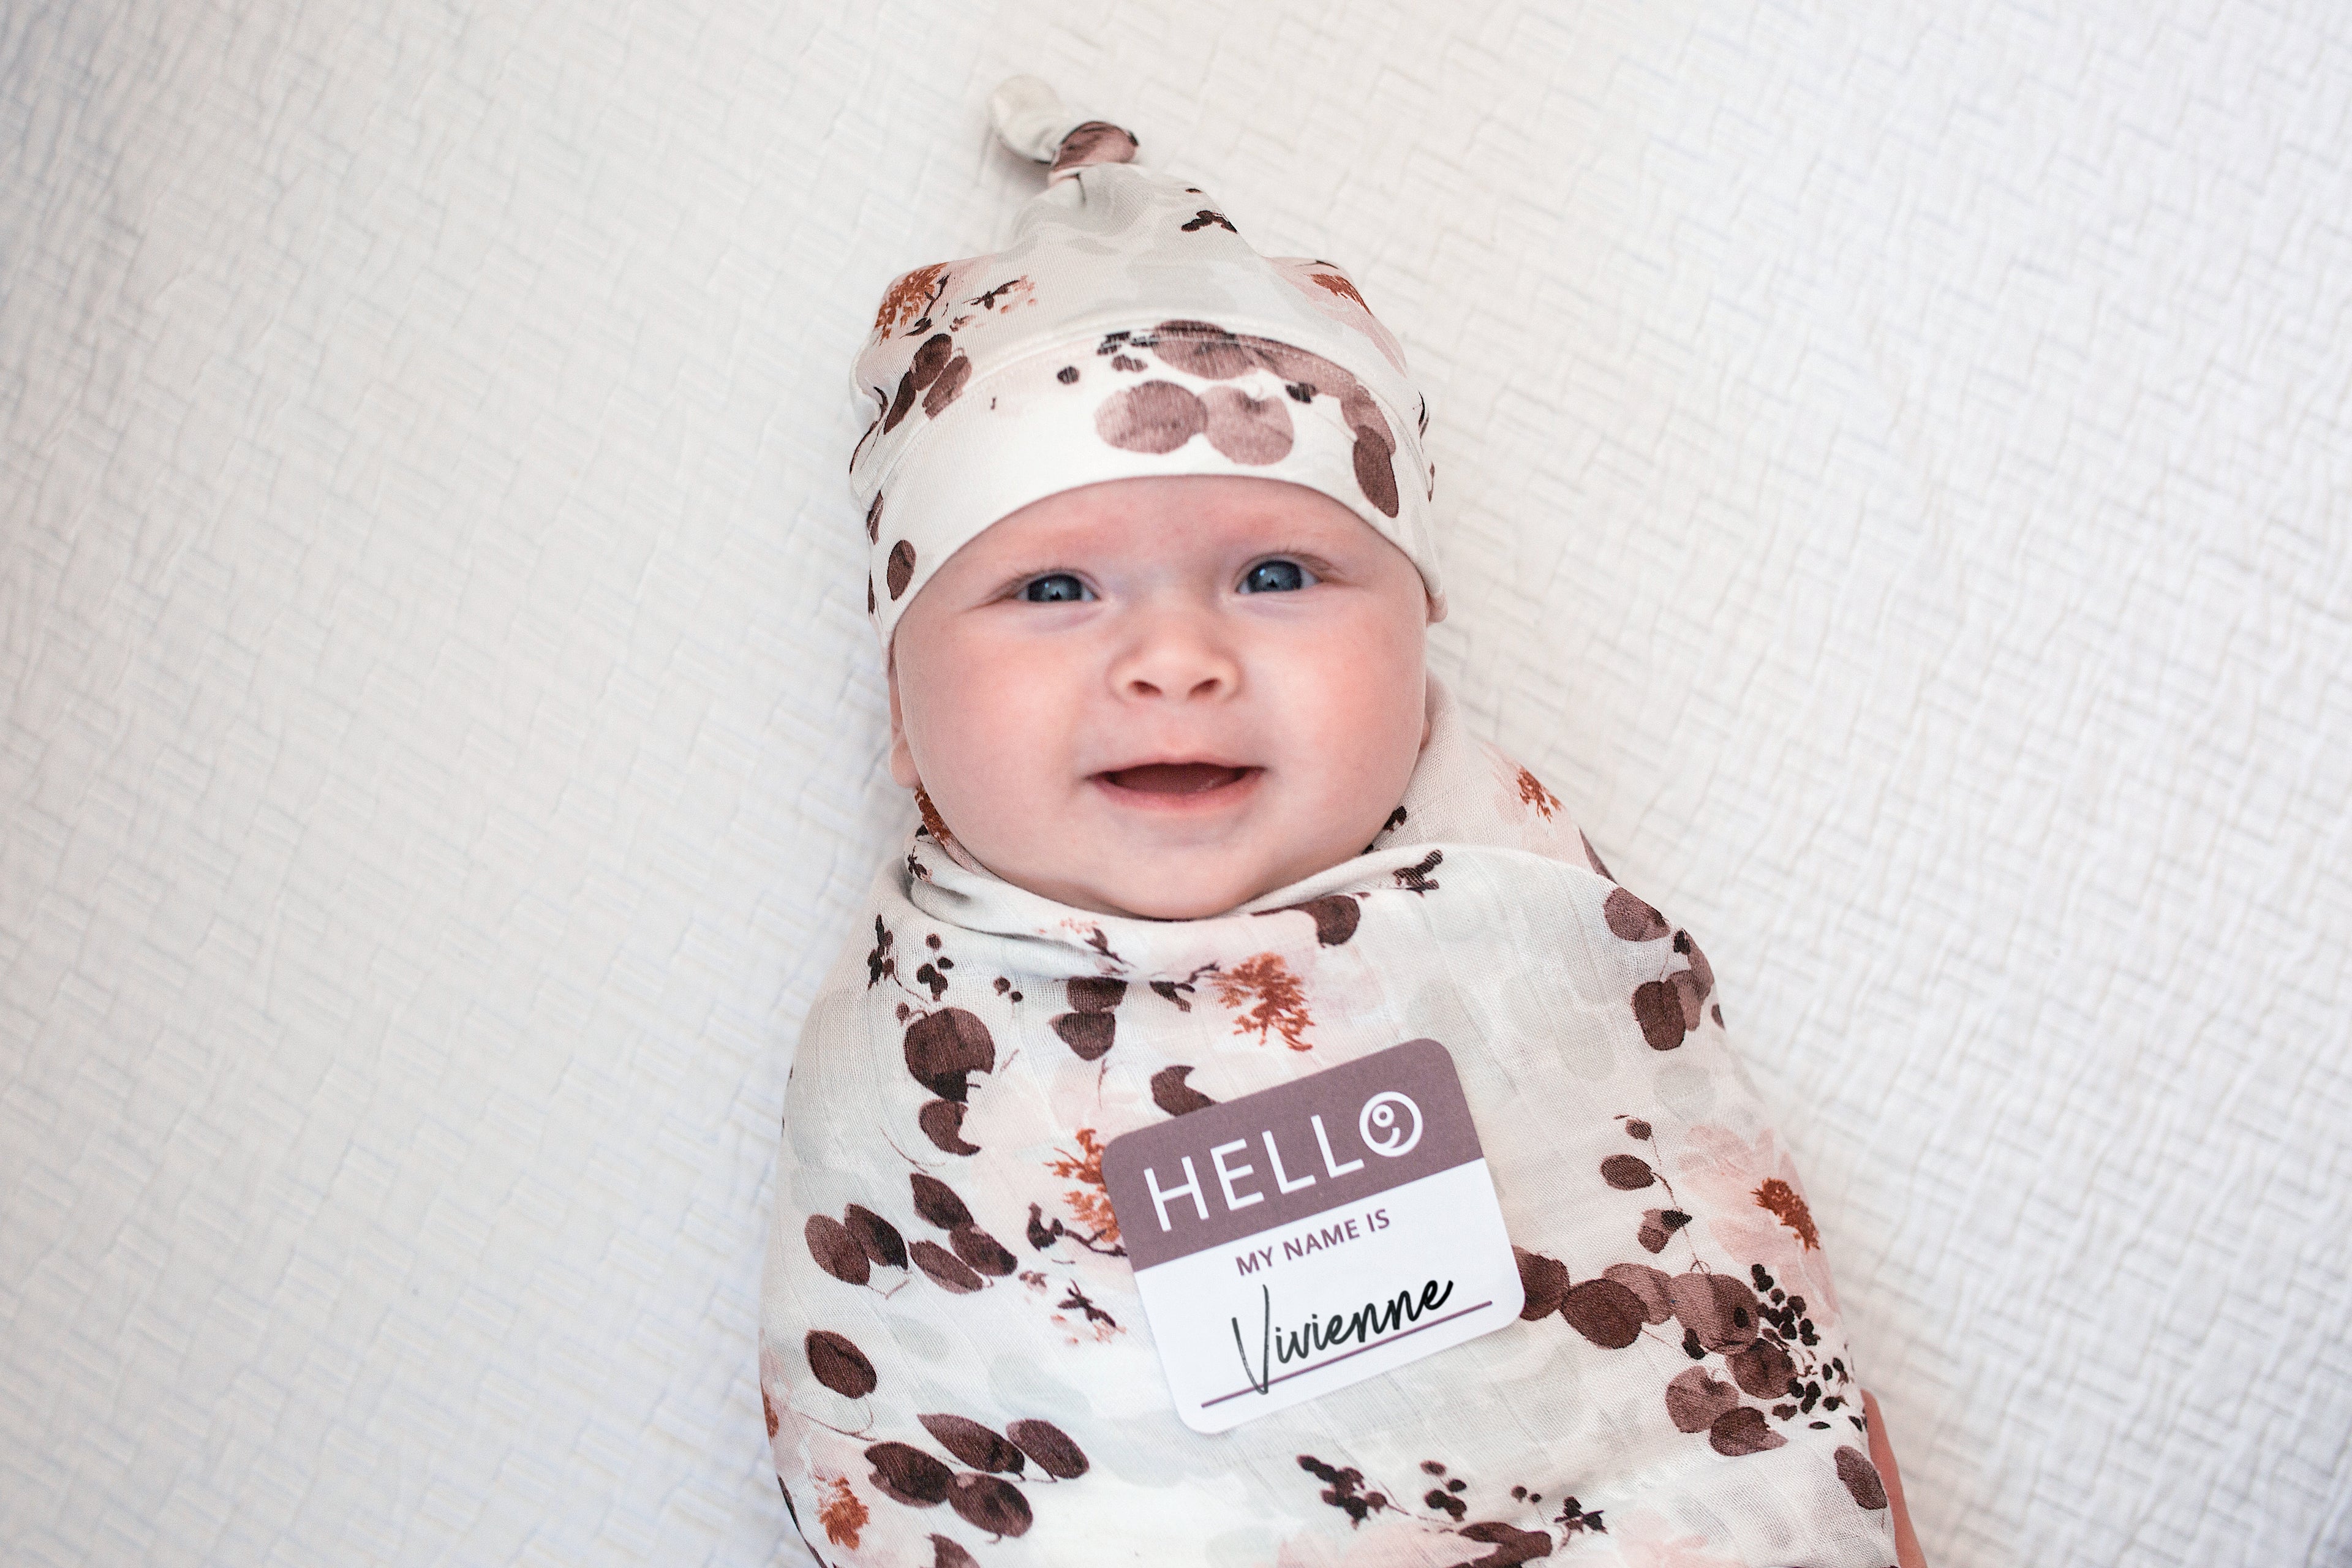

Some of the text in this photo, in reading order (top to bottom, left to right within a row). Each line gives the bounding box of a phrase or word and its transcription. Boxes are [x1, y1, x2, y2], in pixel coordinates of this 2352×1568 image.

[1144, 1091, 1423, 1232] HELLO
[1235, 1208, 1390, 1276] MY NAME IS
[1231, 1280, 1454, 1395] Vivienne
